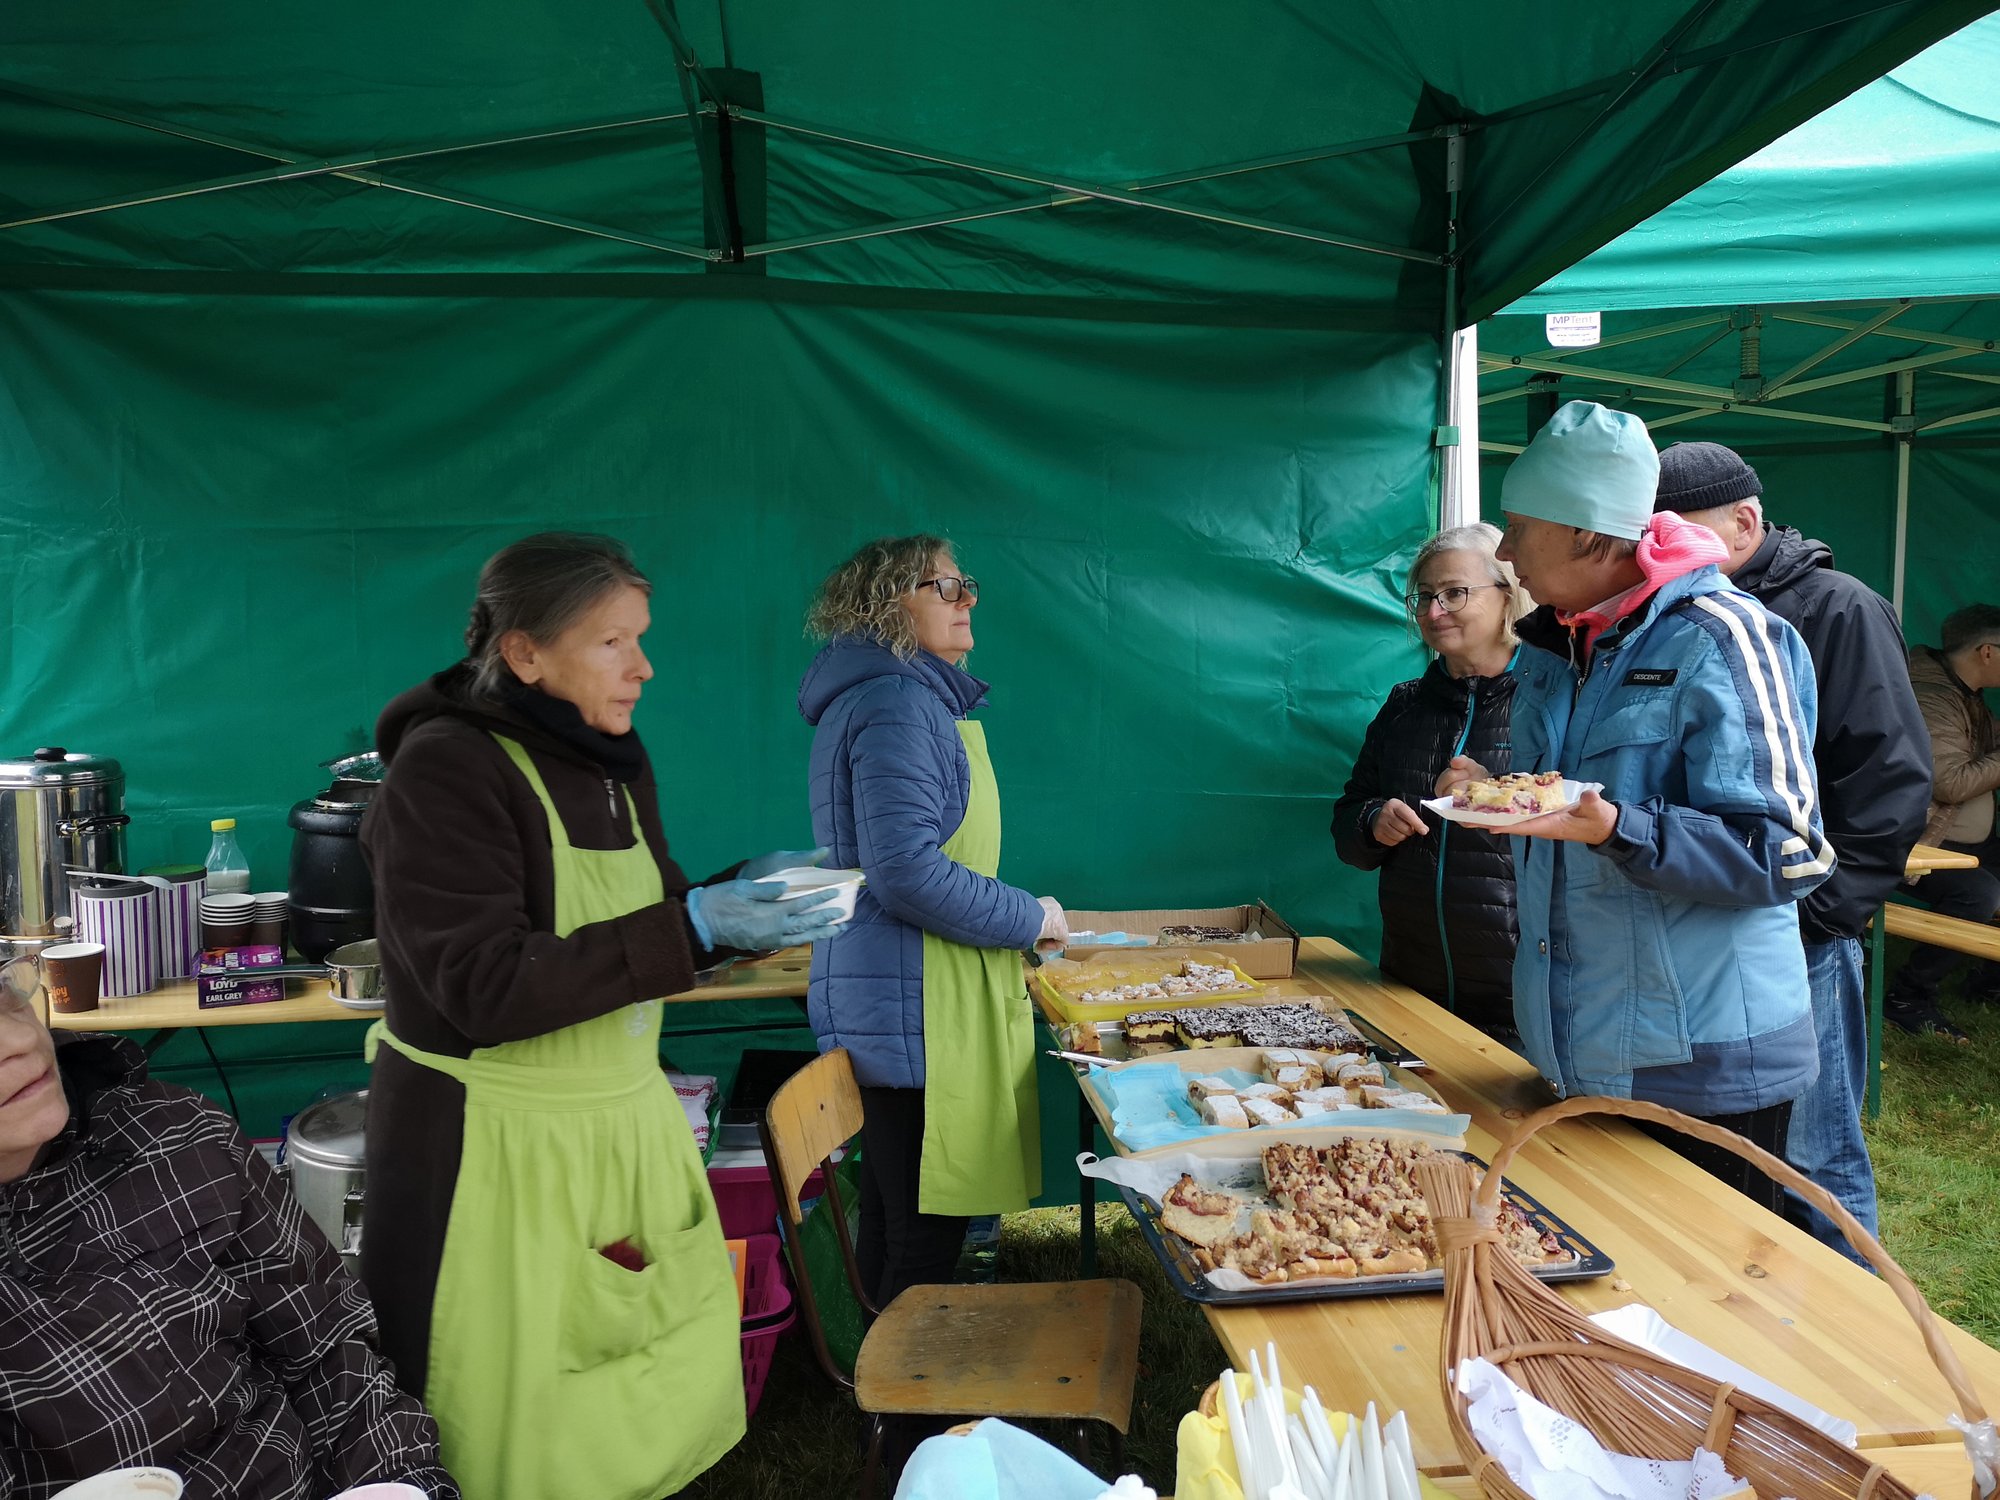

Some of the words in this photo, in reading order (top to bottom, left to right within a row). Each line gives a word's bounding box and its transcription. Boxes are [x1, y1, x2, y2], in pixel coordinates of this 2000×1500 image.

[1552, 315, 1592, 324] MPTent
[209, 980, 238, 991] LOYD
[205, 994, 224, 1003] EARL
[224, 991, 243, 1001] GREY
